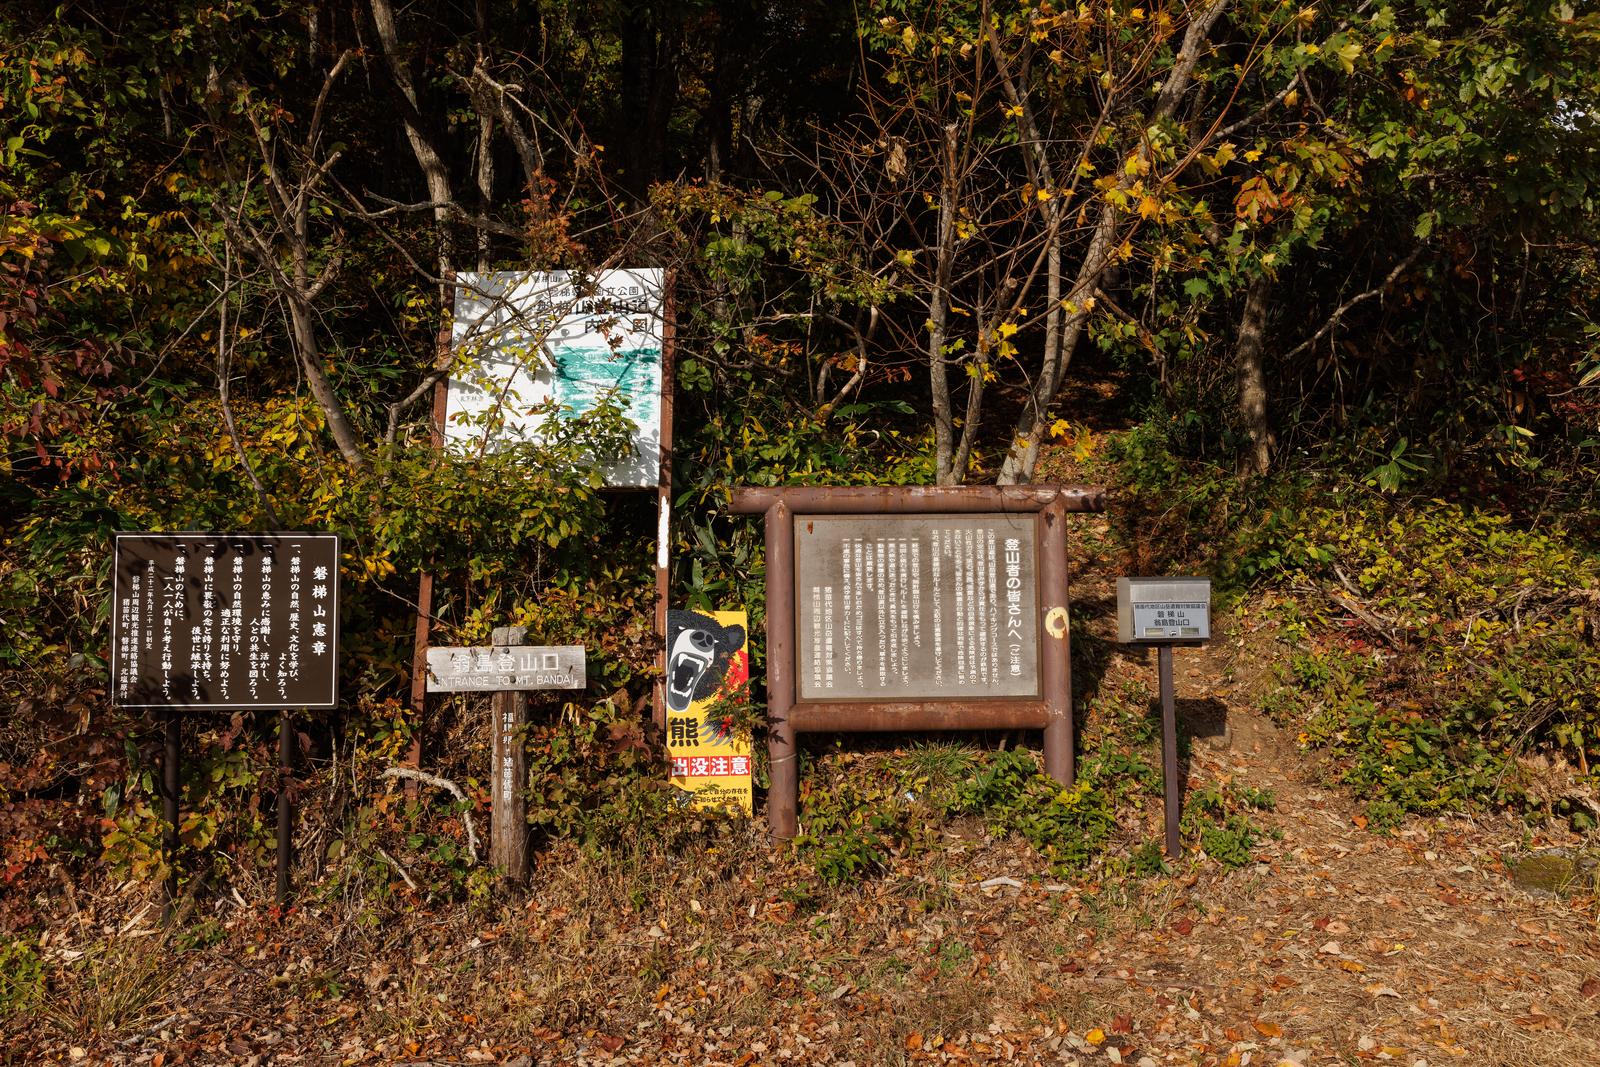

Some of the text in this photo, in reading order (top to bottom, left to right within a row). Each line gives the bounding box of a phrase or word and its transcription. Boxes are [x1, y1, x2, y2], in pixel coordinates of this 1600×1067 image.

[311, 566, 328, 656] 磐梯山憲章
[1157, 610, 1184, 618] 磐梯山
[162, 577, 174, 700] 一人一人が自ら考え行動しよう。
[220, 609, 230, 700] 適正な利用に努めよう。
[249, 618, 260, 699] 人との共生を図ろう。
[191, 627, 202, 700] 後世に継承しよう。
[277, 653, 287, 700] よく知ろう。
[452, 653, 560, 673] 翁島登山口
[496, 675, 511, 686] TO
[516, 675, 534, 686] MT.
[670, 717, 699, 747] 熊
[671, 756, 749, 776] 出没注意
